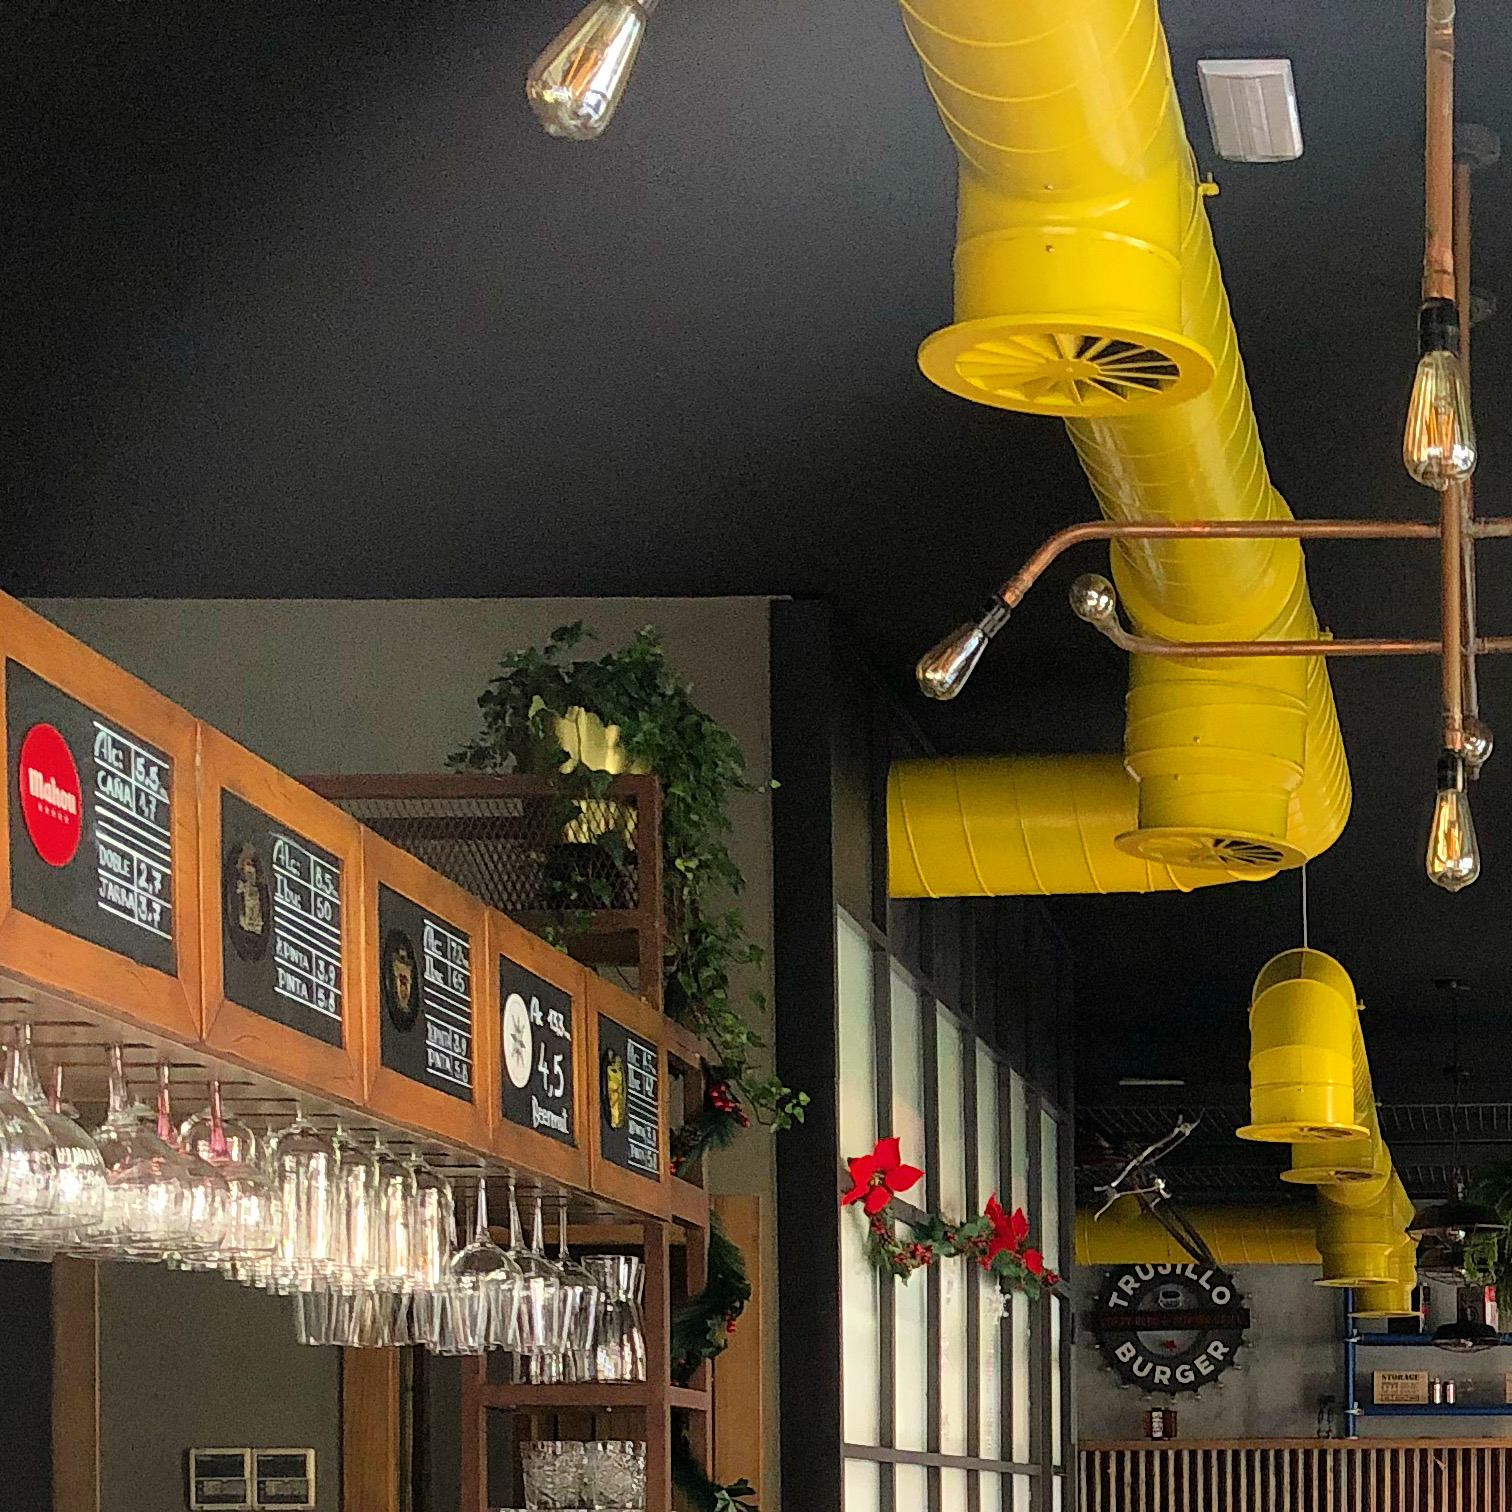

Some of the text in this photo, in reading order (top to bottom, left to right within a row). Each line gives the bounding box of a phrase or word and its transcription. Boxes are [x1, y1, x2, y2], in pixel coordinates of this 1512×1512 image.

[28, 767, 77, 815] Mahou
[98, 770, 133, 808] CAÑA
[99, 844, 131, 877] DOBLE
[99, 877, 135, 909] JARRA
[316, 898, 332, 922] 50
[277, 966, 310, 1001] PINTA
[1108, 1264, 1231, 1308] TRUJILLO
[1114, 1340, 1230, 1385] BURGER
[1381, 1373, 1419, 1381] STORAGE
